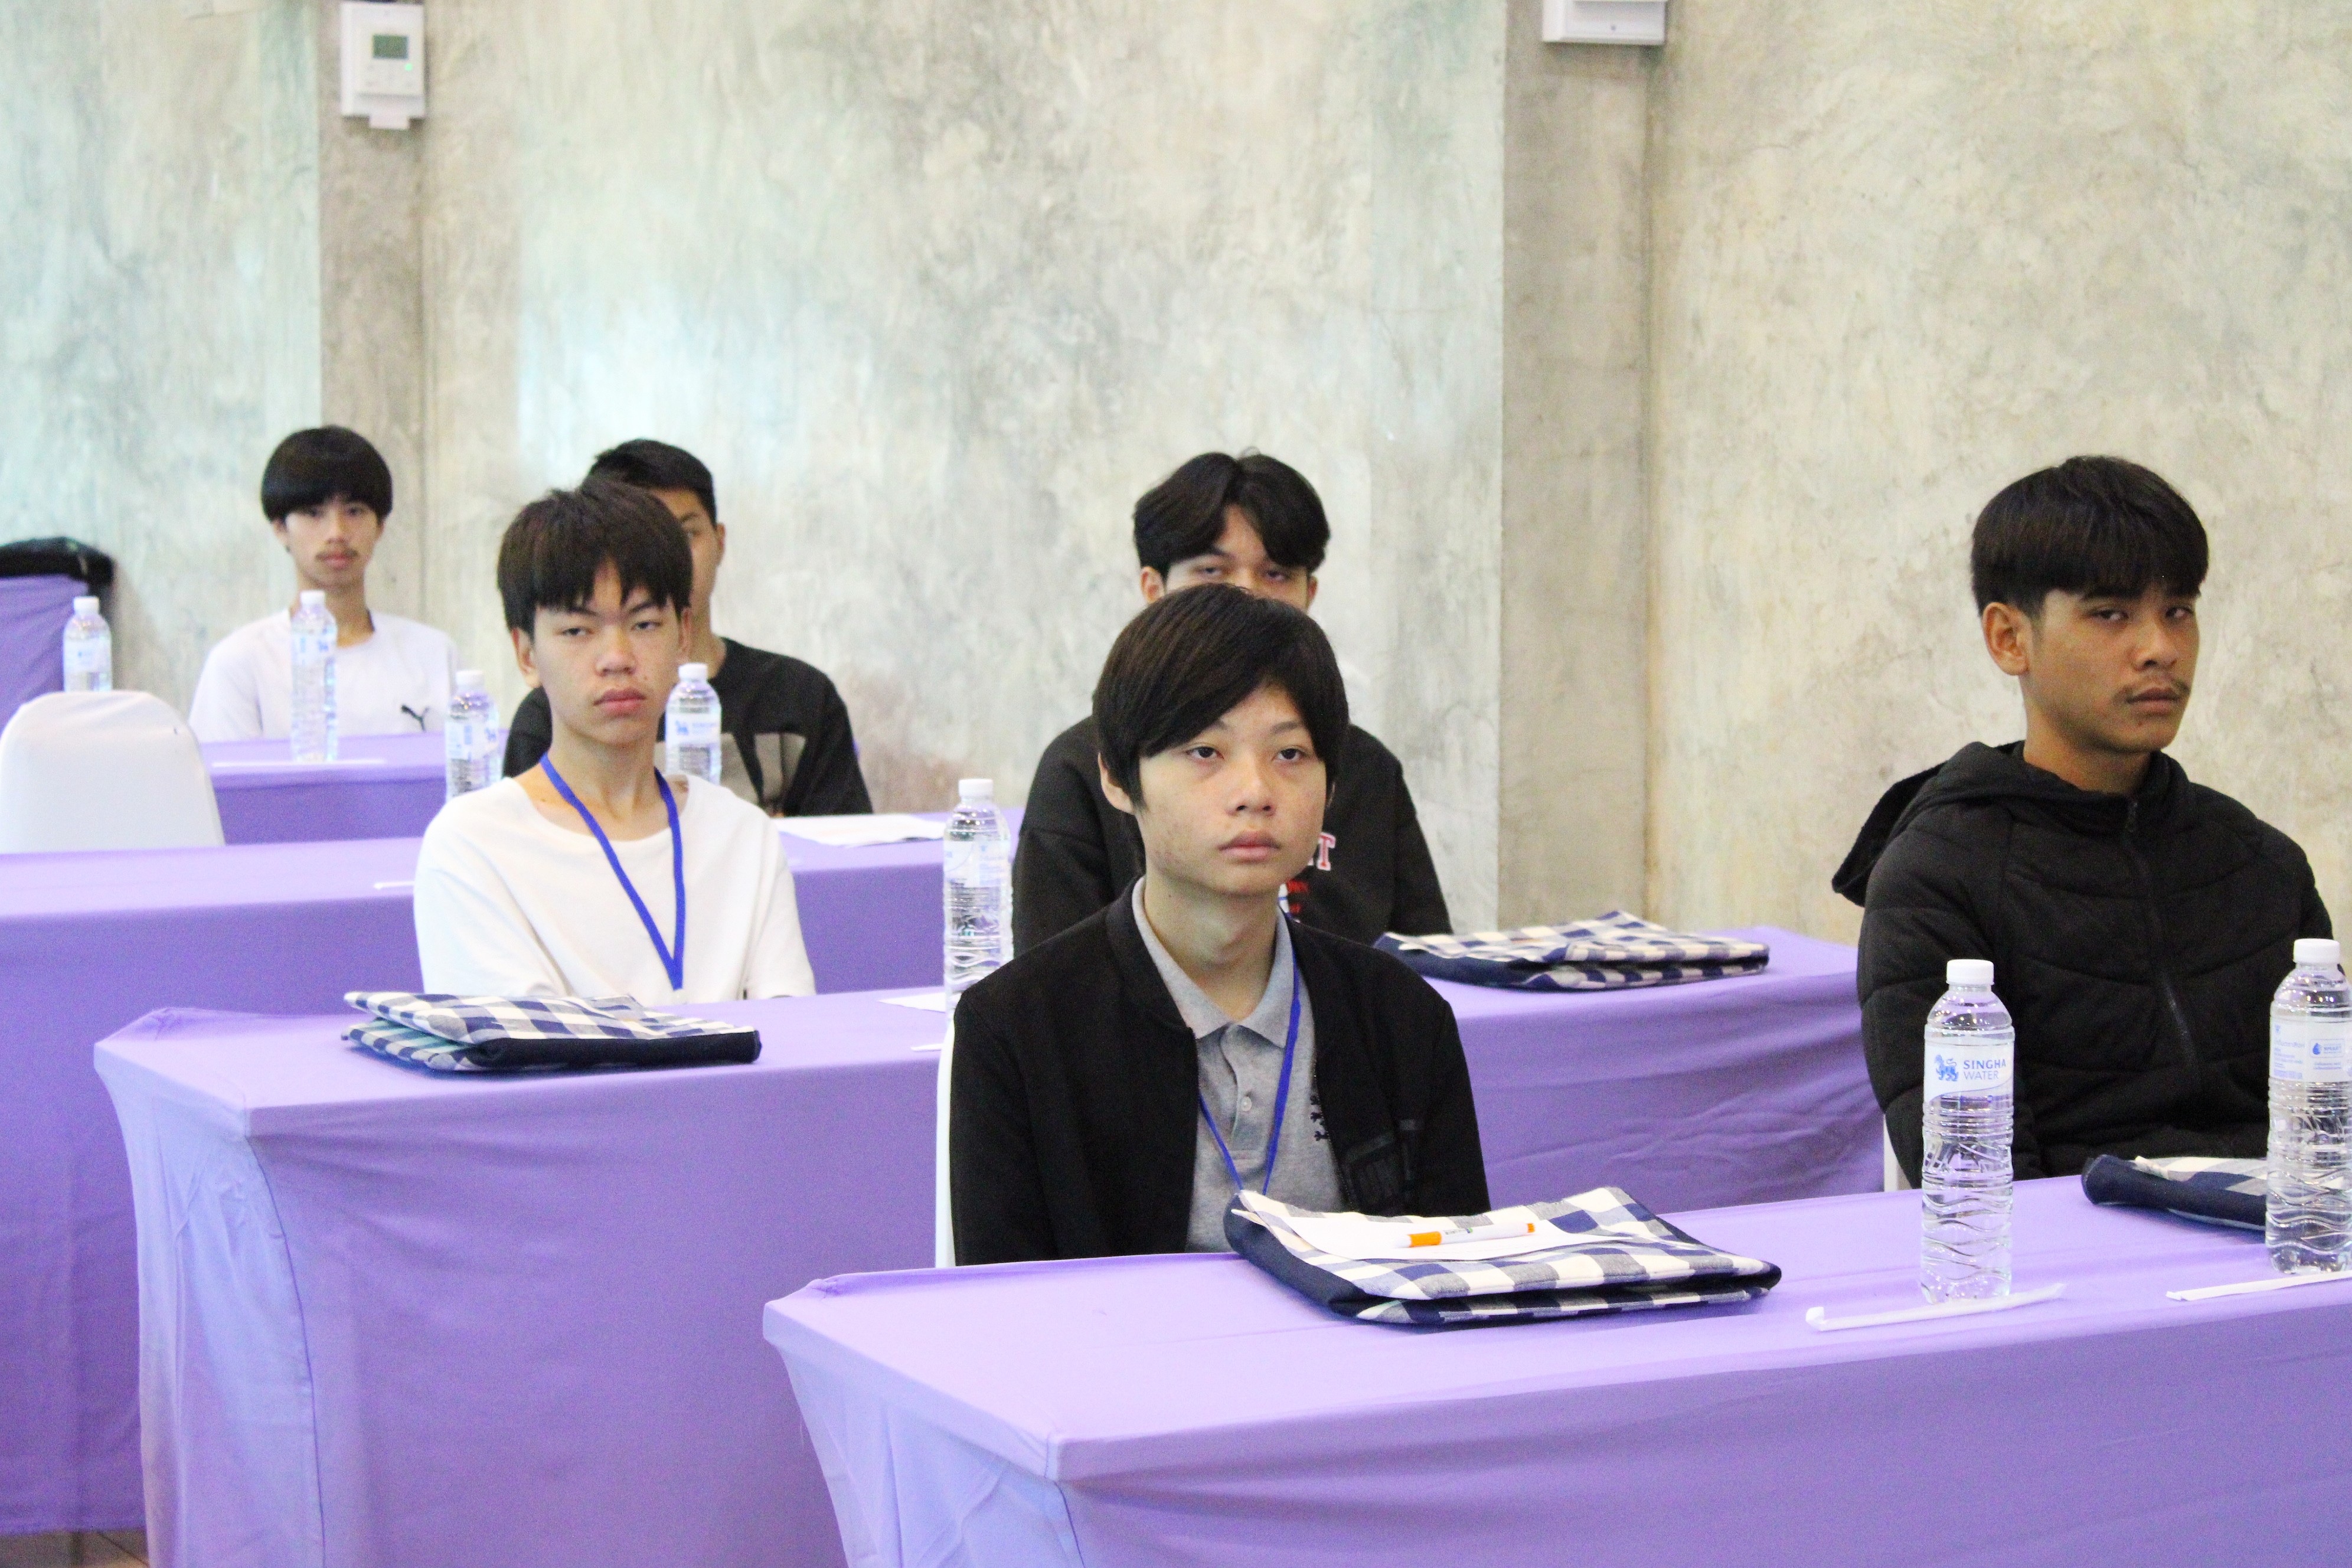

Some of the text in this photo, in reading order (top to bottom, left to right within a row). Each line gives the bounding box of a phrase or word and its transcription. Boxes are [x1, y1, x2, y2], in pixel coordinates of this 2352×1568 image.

[1308, 832, 1335, 871] T
[1964, 1059, 2006, 1069] SINGHA
[1964, 1071, 1999, 1080] WATER
